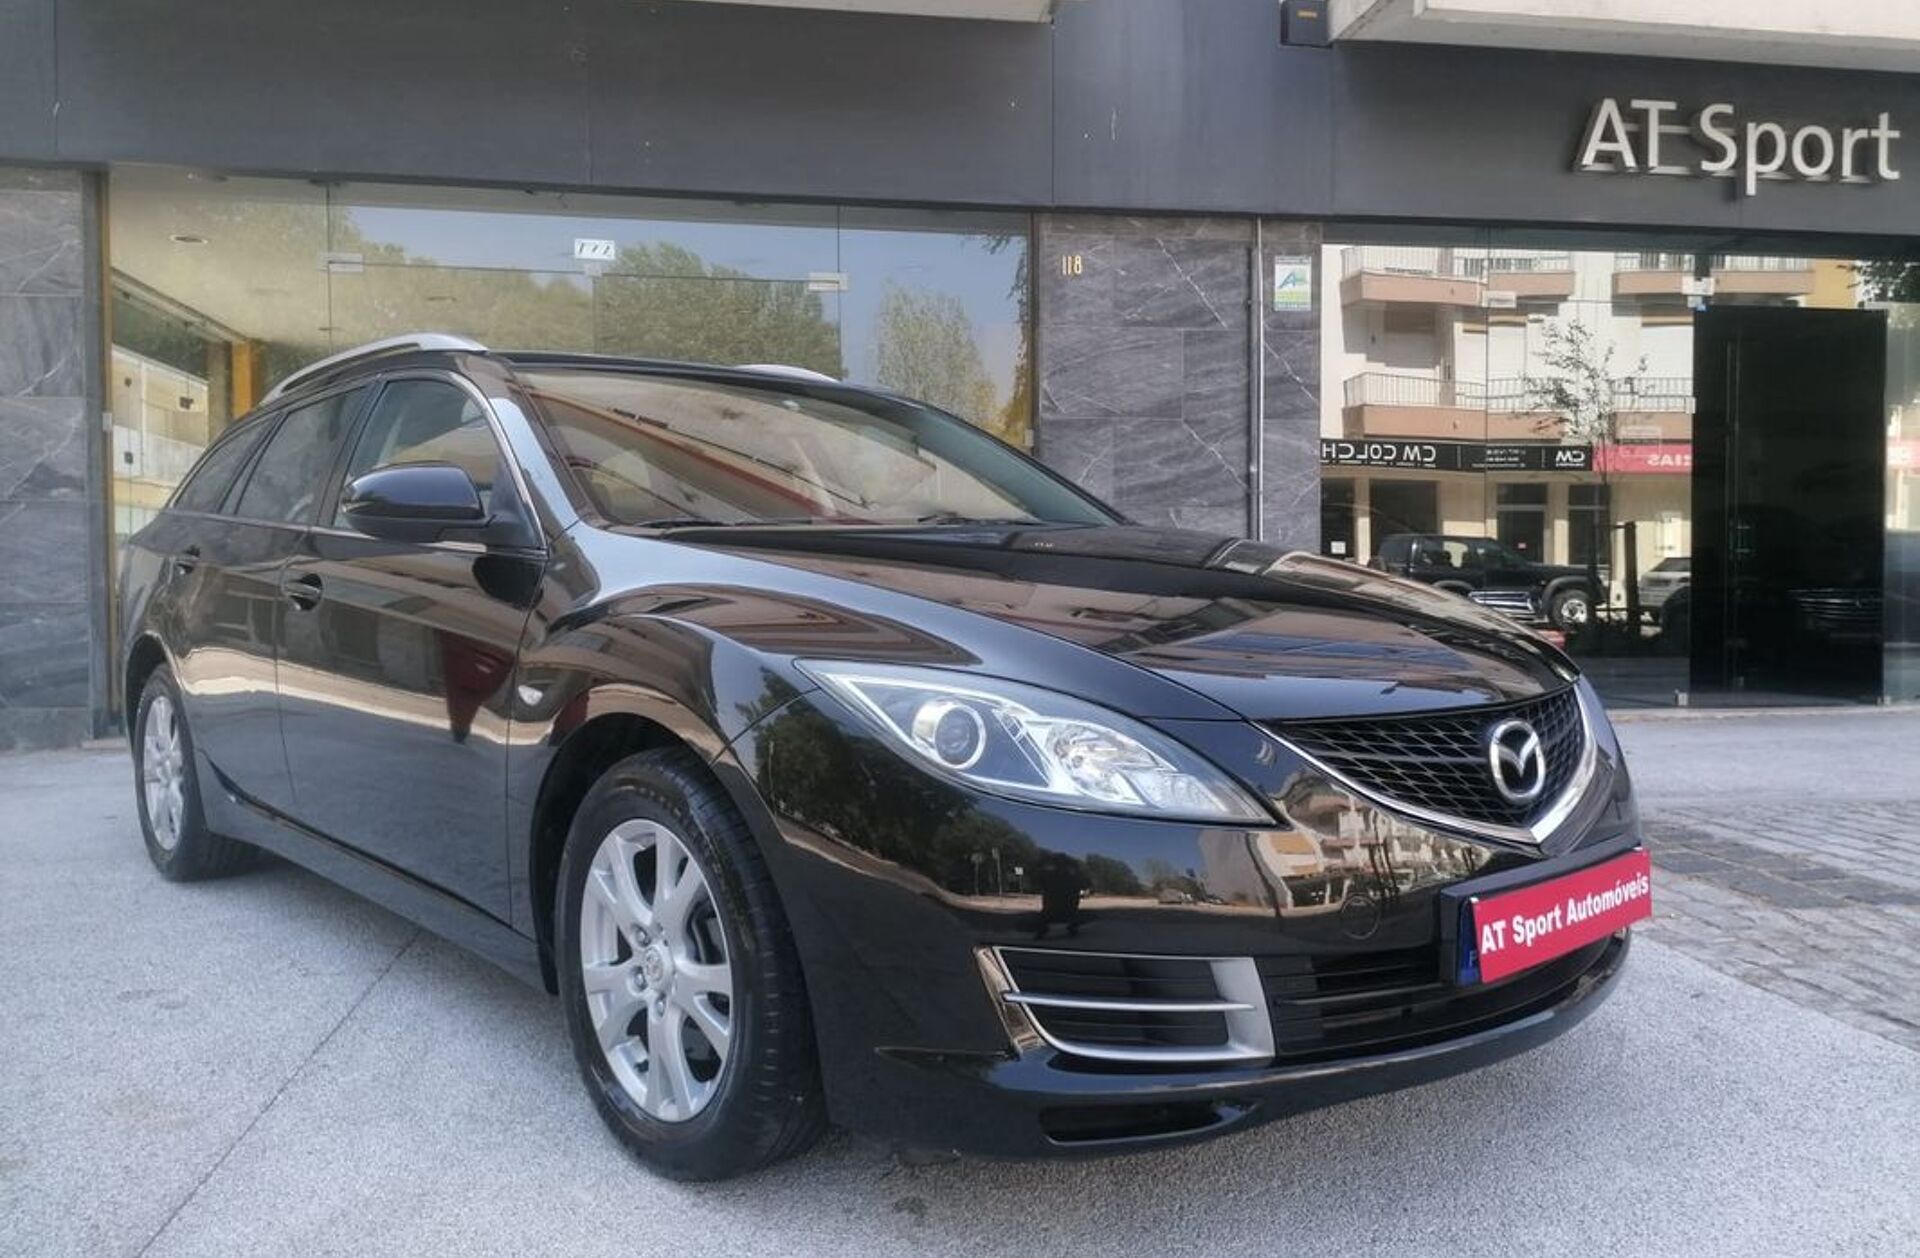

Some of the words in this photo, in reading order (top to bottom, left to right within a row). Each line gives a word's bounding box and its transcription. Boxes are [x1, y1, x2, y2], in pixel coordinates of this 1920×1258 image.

[1581, 98, 1677, 168] AT
[1700, 103, 1900, 196] Sport
[1062, 255, 1082, 275] 118
[1481, 919, 1507, 955] AT
[1512, 905, 1562, 946] Sport
[1566, 872, 1649, 926] Automóveis
